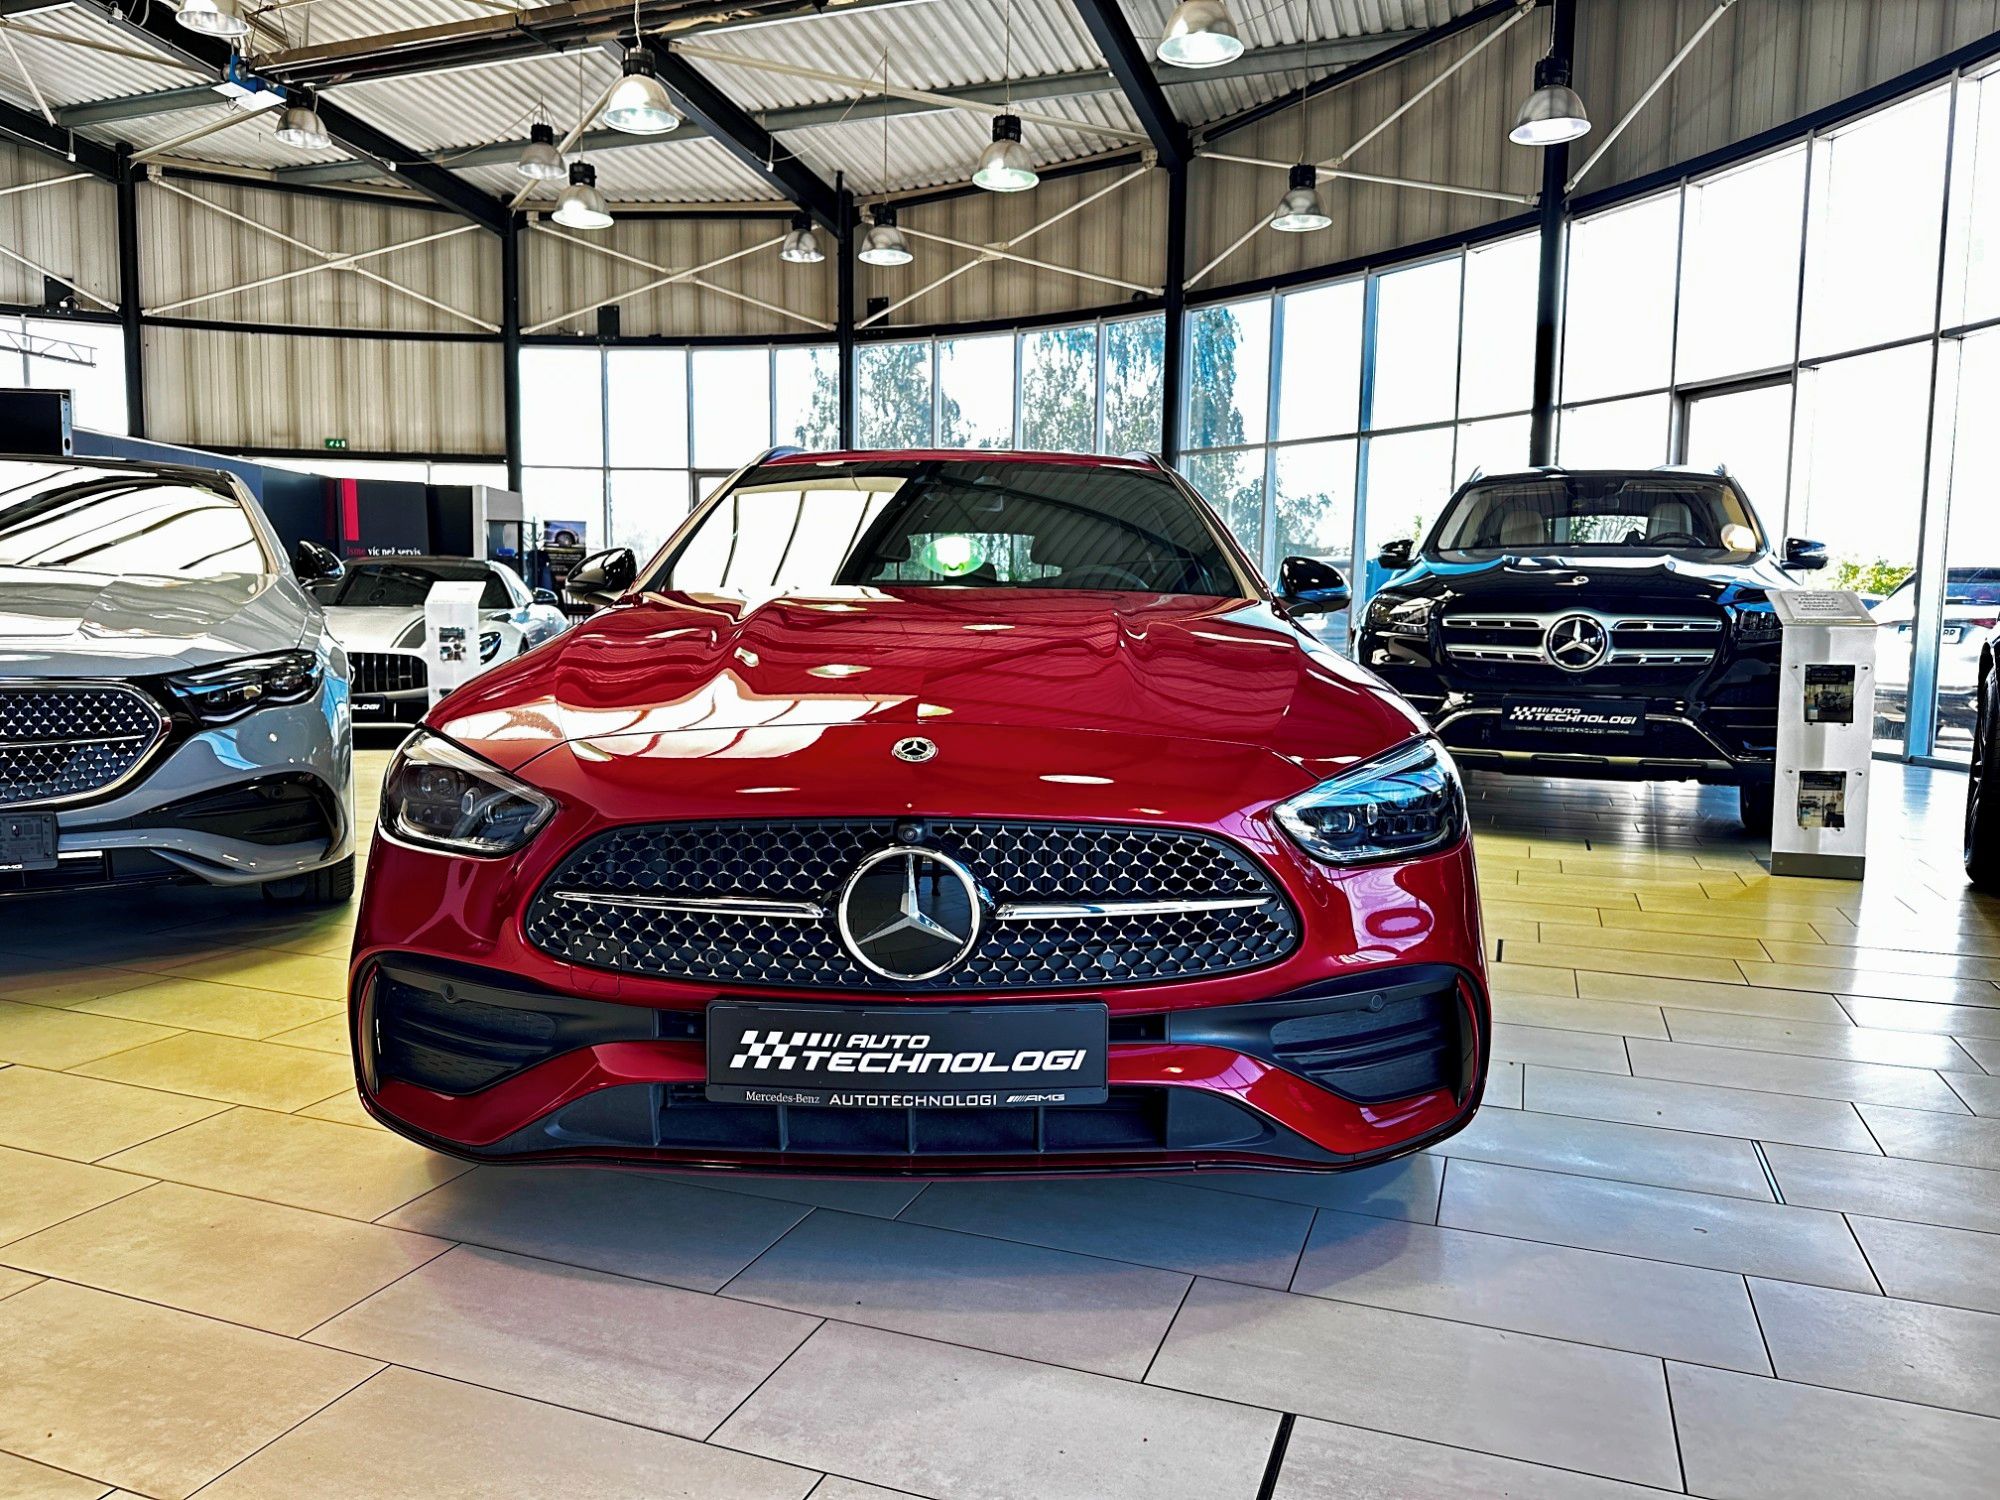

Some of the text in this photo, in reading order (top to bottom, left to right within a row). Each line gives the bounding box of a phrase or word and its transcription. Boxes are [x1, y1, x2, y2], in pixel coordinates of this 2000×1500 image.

[397, 547, 421, 556] servis
[1535, 713, 1637, 725] TECHNOLOGI
[846, 1034, 930, 1049] AUTO
[801, 1049, 1087, 1073] TECHNOLOGI
[745, 1090, 1065, 1107] Mercedes-Benz AUTOTECHNOLOGI AMG
